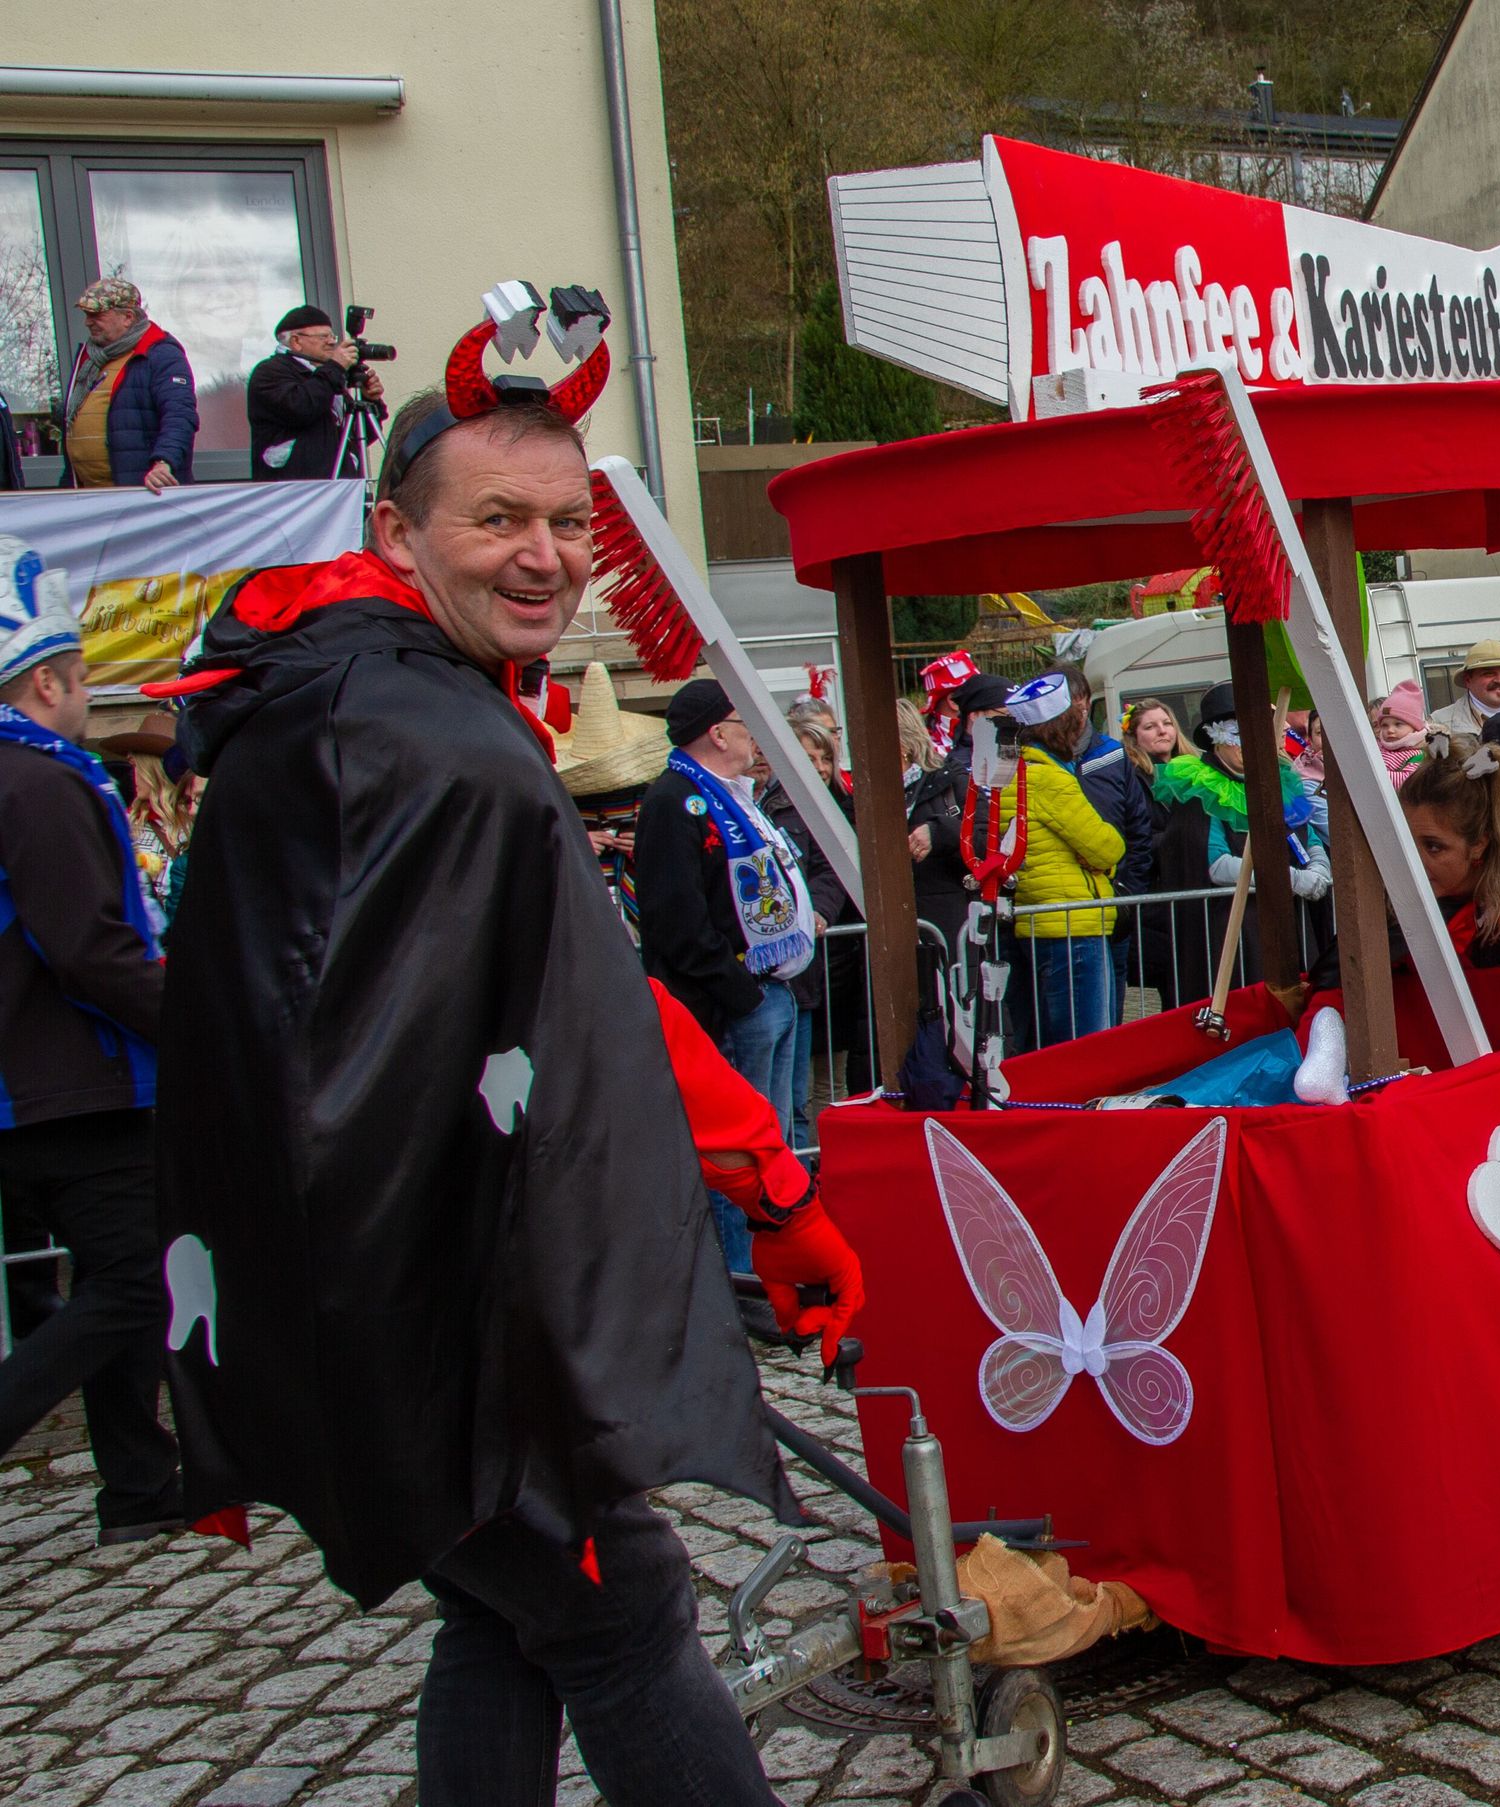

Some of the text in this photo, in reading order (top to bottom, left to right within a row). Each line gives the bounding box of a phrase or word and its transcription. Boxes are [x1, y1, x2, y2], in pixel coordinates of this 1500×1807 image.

[1028, 235, 1261, 380] Zahnfee
[1269, 286, 1304, 381] &
[724, 820, 747, 844] KV
